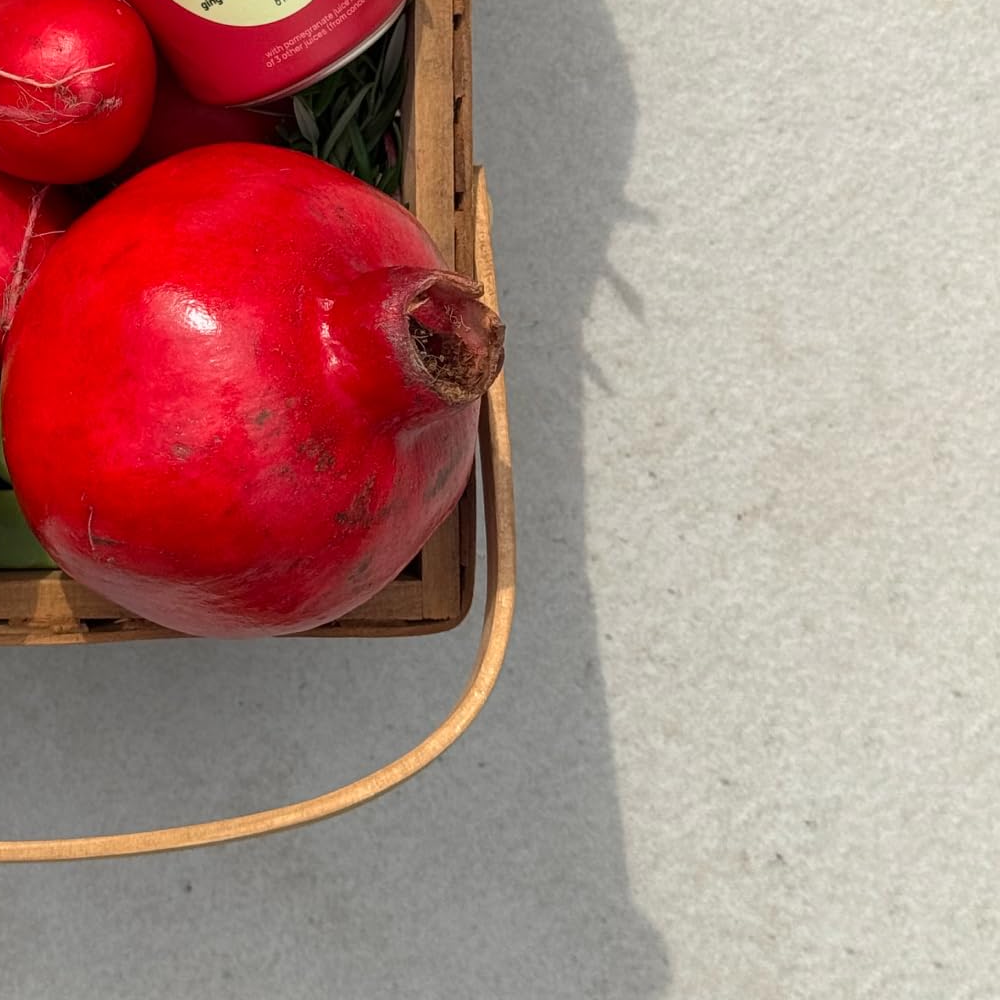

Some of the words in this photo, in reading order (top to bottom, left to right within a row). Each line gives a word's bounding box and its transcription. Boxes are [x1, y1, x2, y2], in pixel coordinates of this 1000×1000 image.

[265, 45, 285, 58] with
[283, 12, 334, 48] pomegranate
[333, 0, 350, 17] juice
[266, 58, 275, 68] of
[274, 55, 282, 63] 3
[281, 44, 304, 60] other
[303, 28, 328, 48] juices
[326, 13, 348, 32] (from
